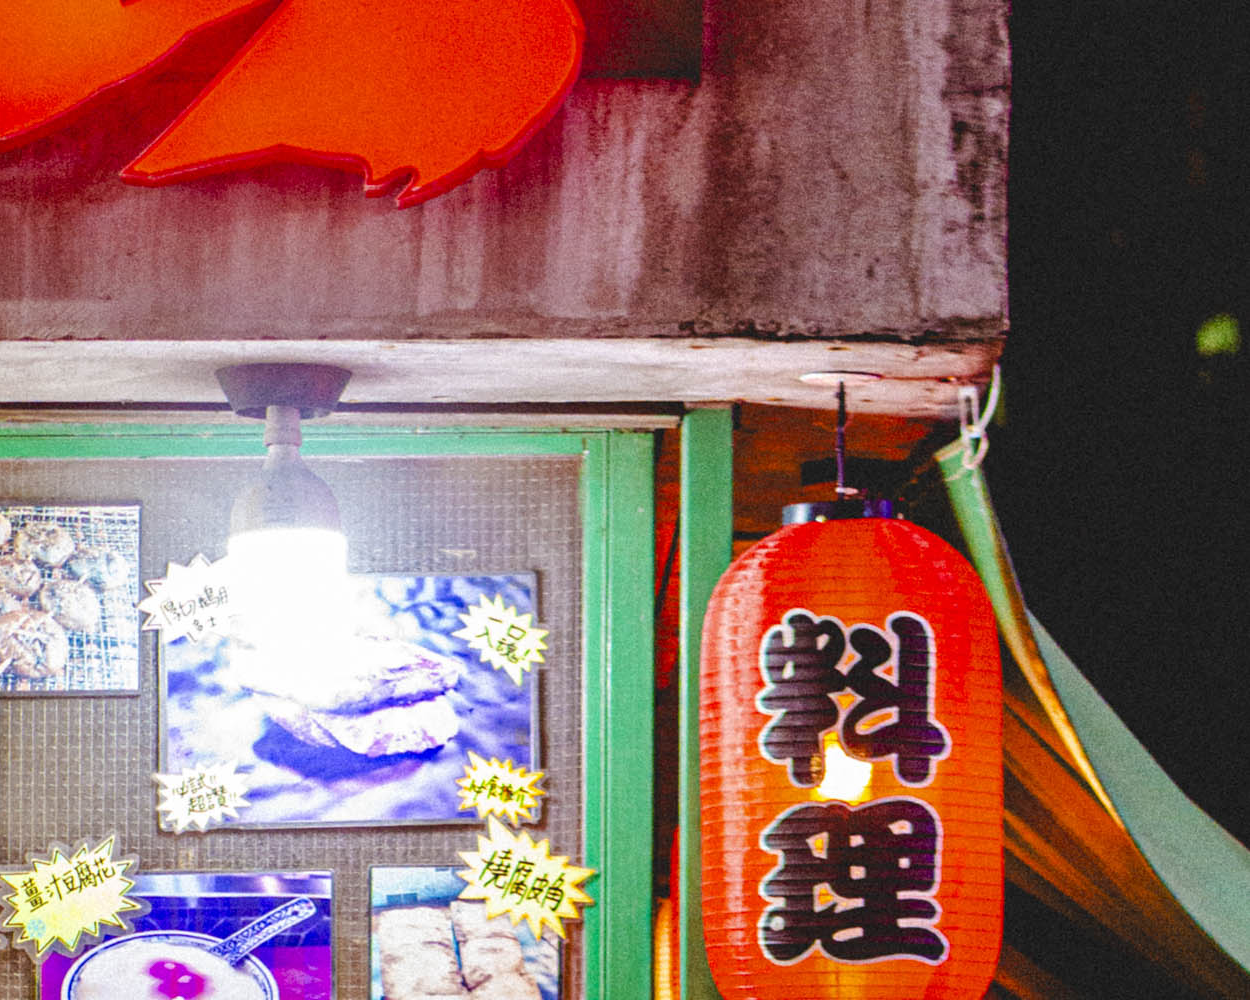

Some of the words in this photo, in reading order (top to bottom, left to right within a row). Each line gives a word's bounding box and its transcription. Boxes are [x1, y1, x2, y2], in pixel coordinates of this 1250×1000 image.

[21, 858, 116, 913] 薑汁豆腐花
[755, 608, 952, 967] 料理
